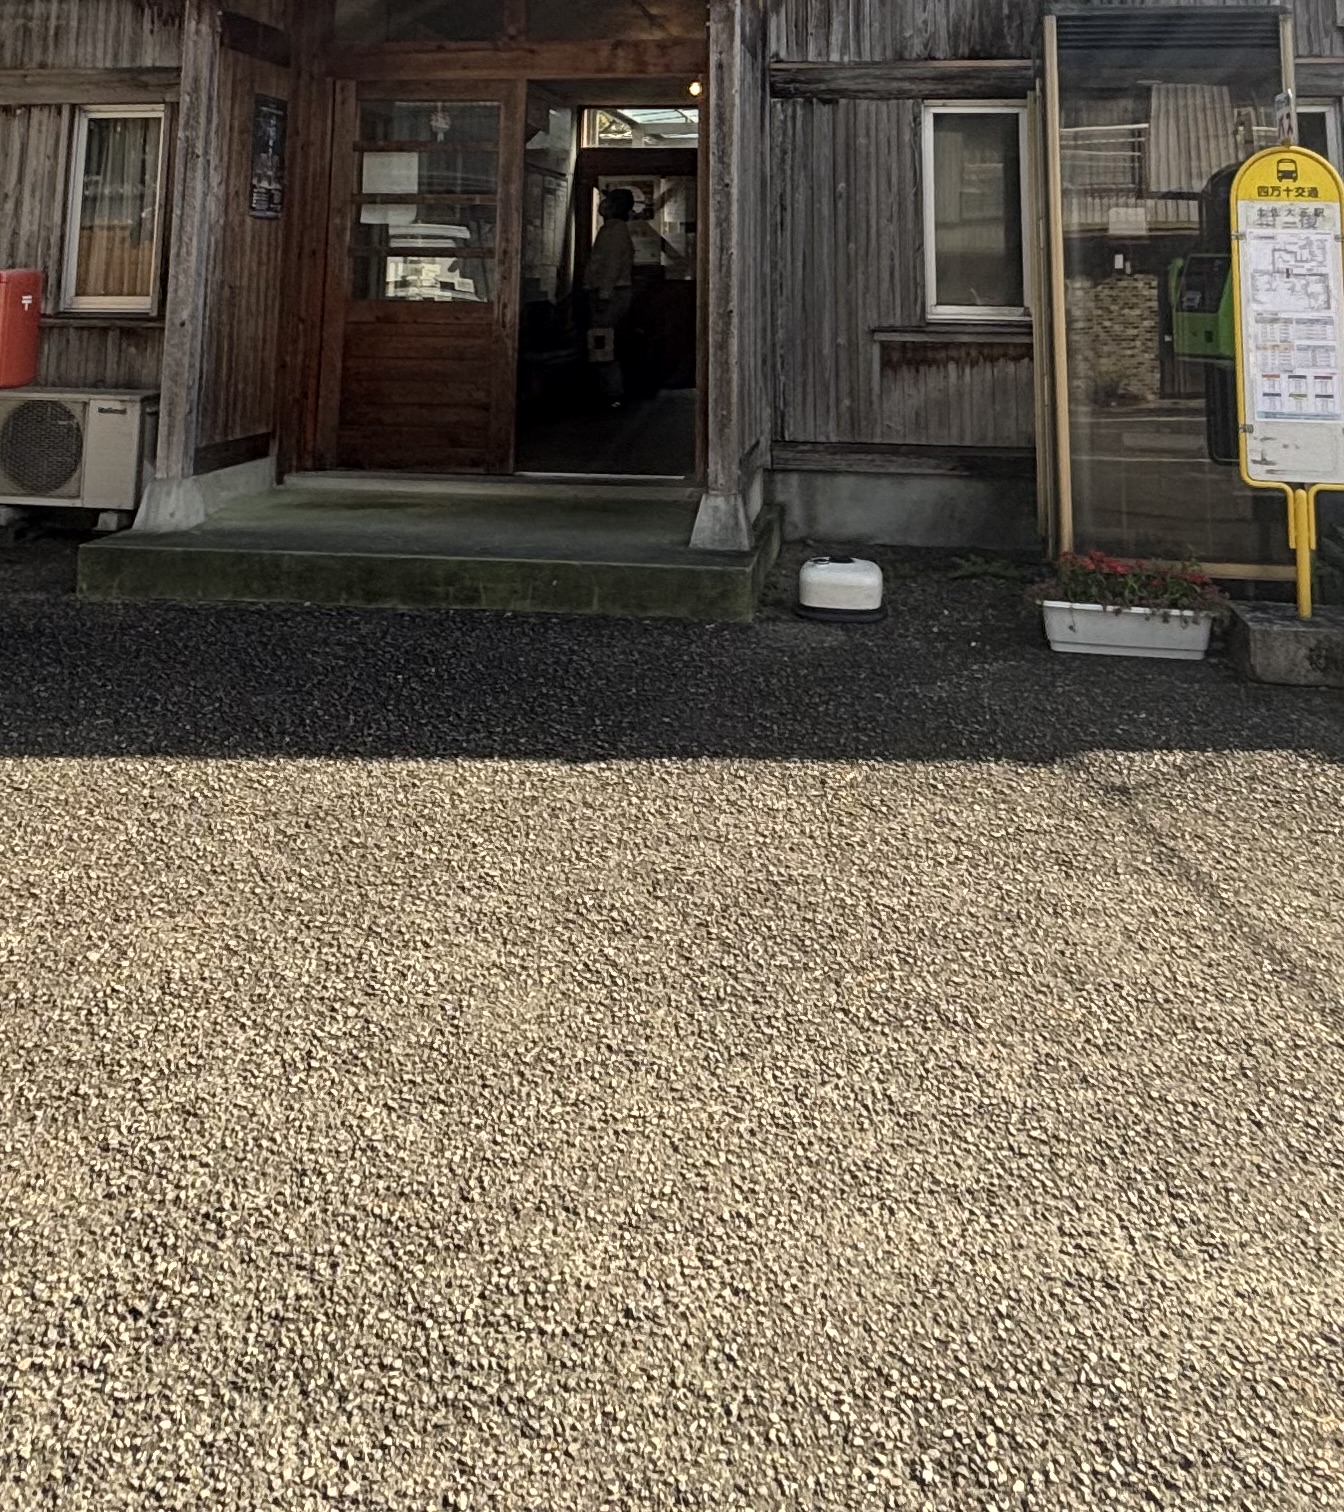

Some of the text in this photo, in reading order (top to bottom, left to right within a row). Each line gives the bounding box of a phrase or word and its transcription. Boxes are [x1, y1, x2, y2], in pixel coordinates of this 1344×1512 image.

[1257, 185, 1319, 199] 四万十交通
